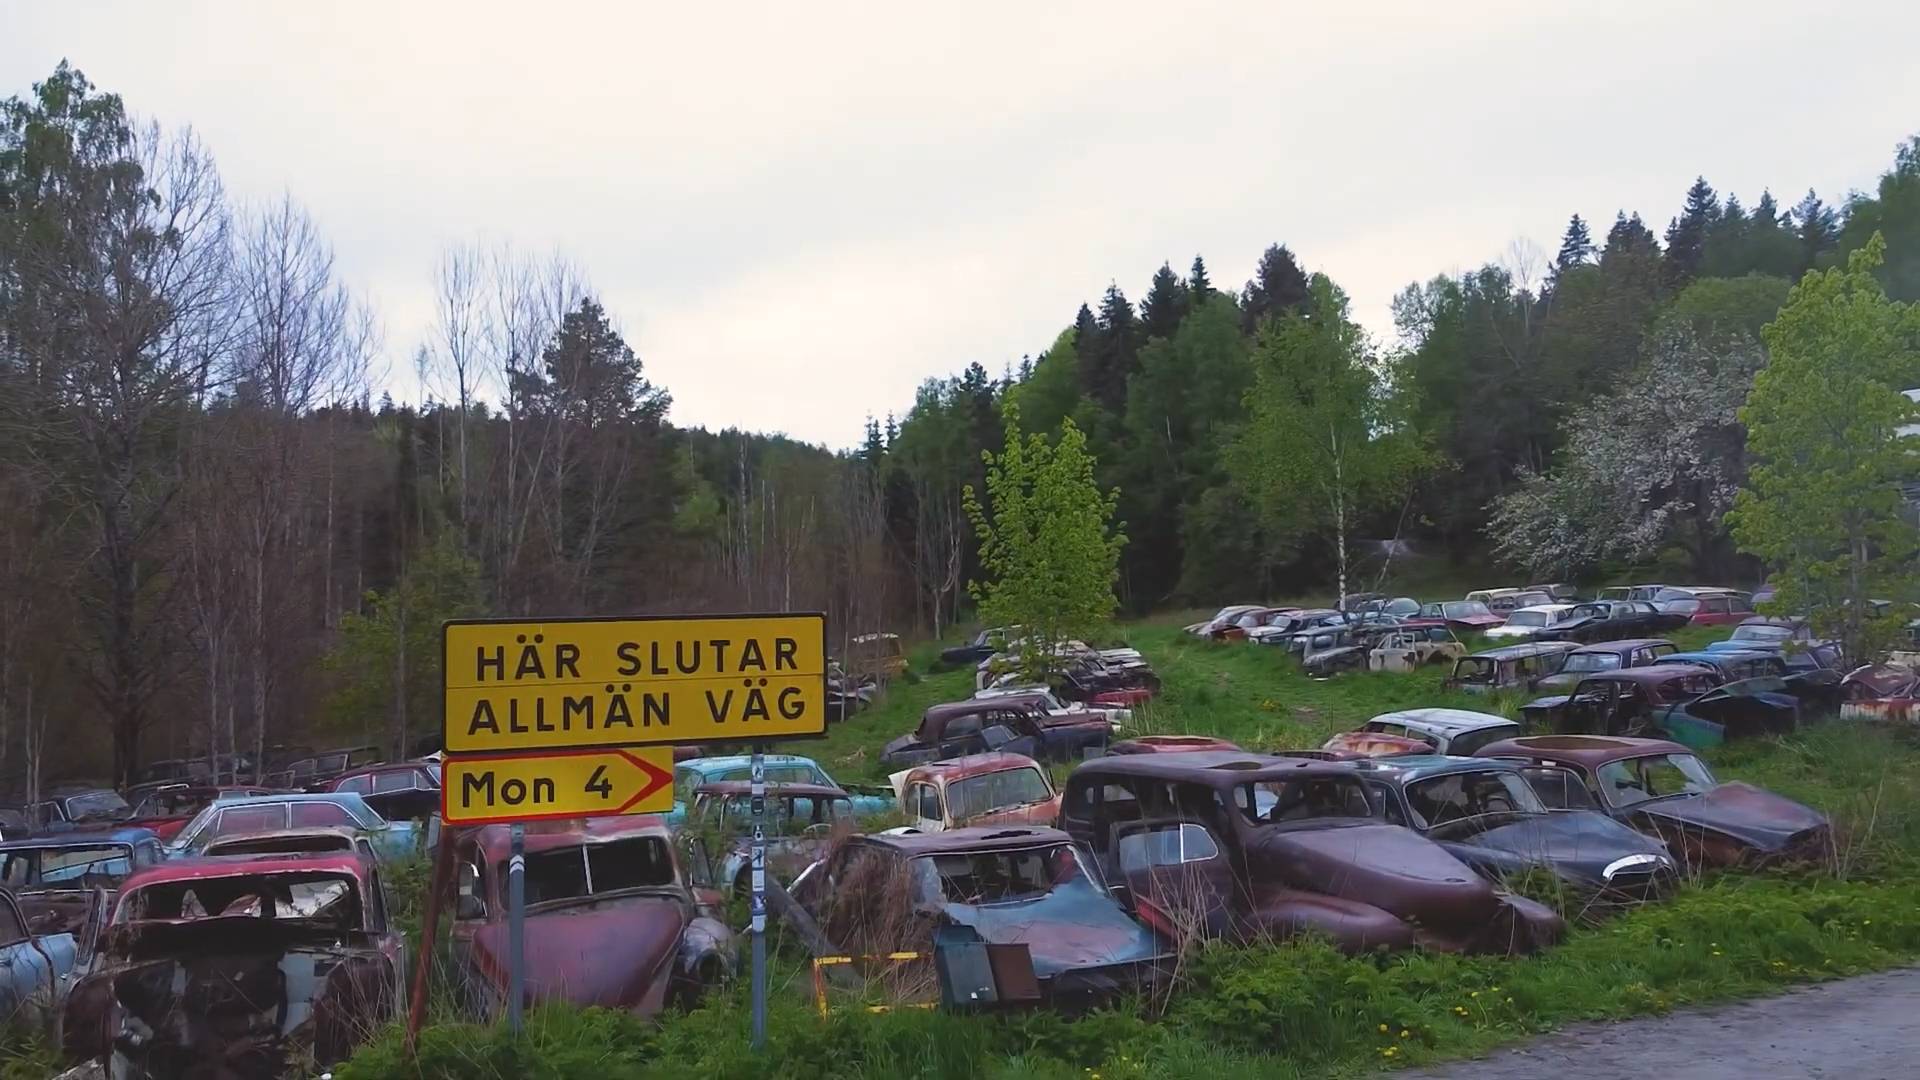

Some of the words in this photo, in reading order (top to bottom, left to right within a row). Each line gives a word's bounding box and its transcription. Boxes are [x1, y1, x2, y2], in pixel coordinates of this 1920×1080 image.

[476, 633, 581, 681] HÄR
[616, 638, 798, 676] SLUTAR
[467, 683, 670, 735] ALLMÄN
[705, 678, 805, 723] VÄG
[461, 771, 555, 808] Mon
[584, 765, 612, 799] 4
